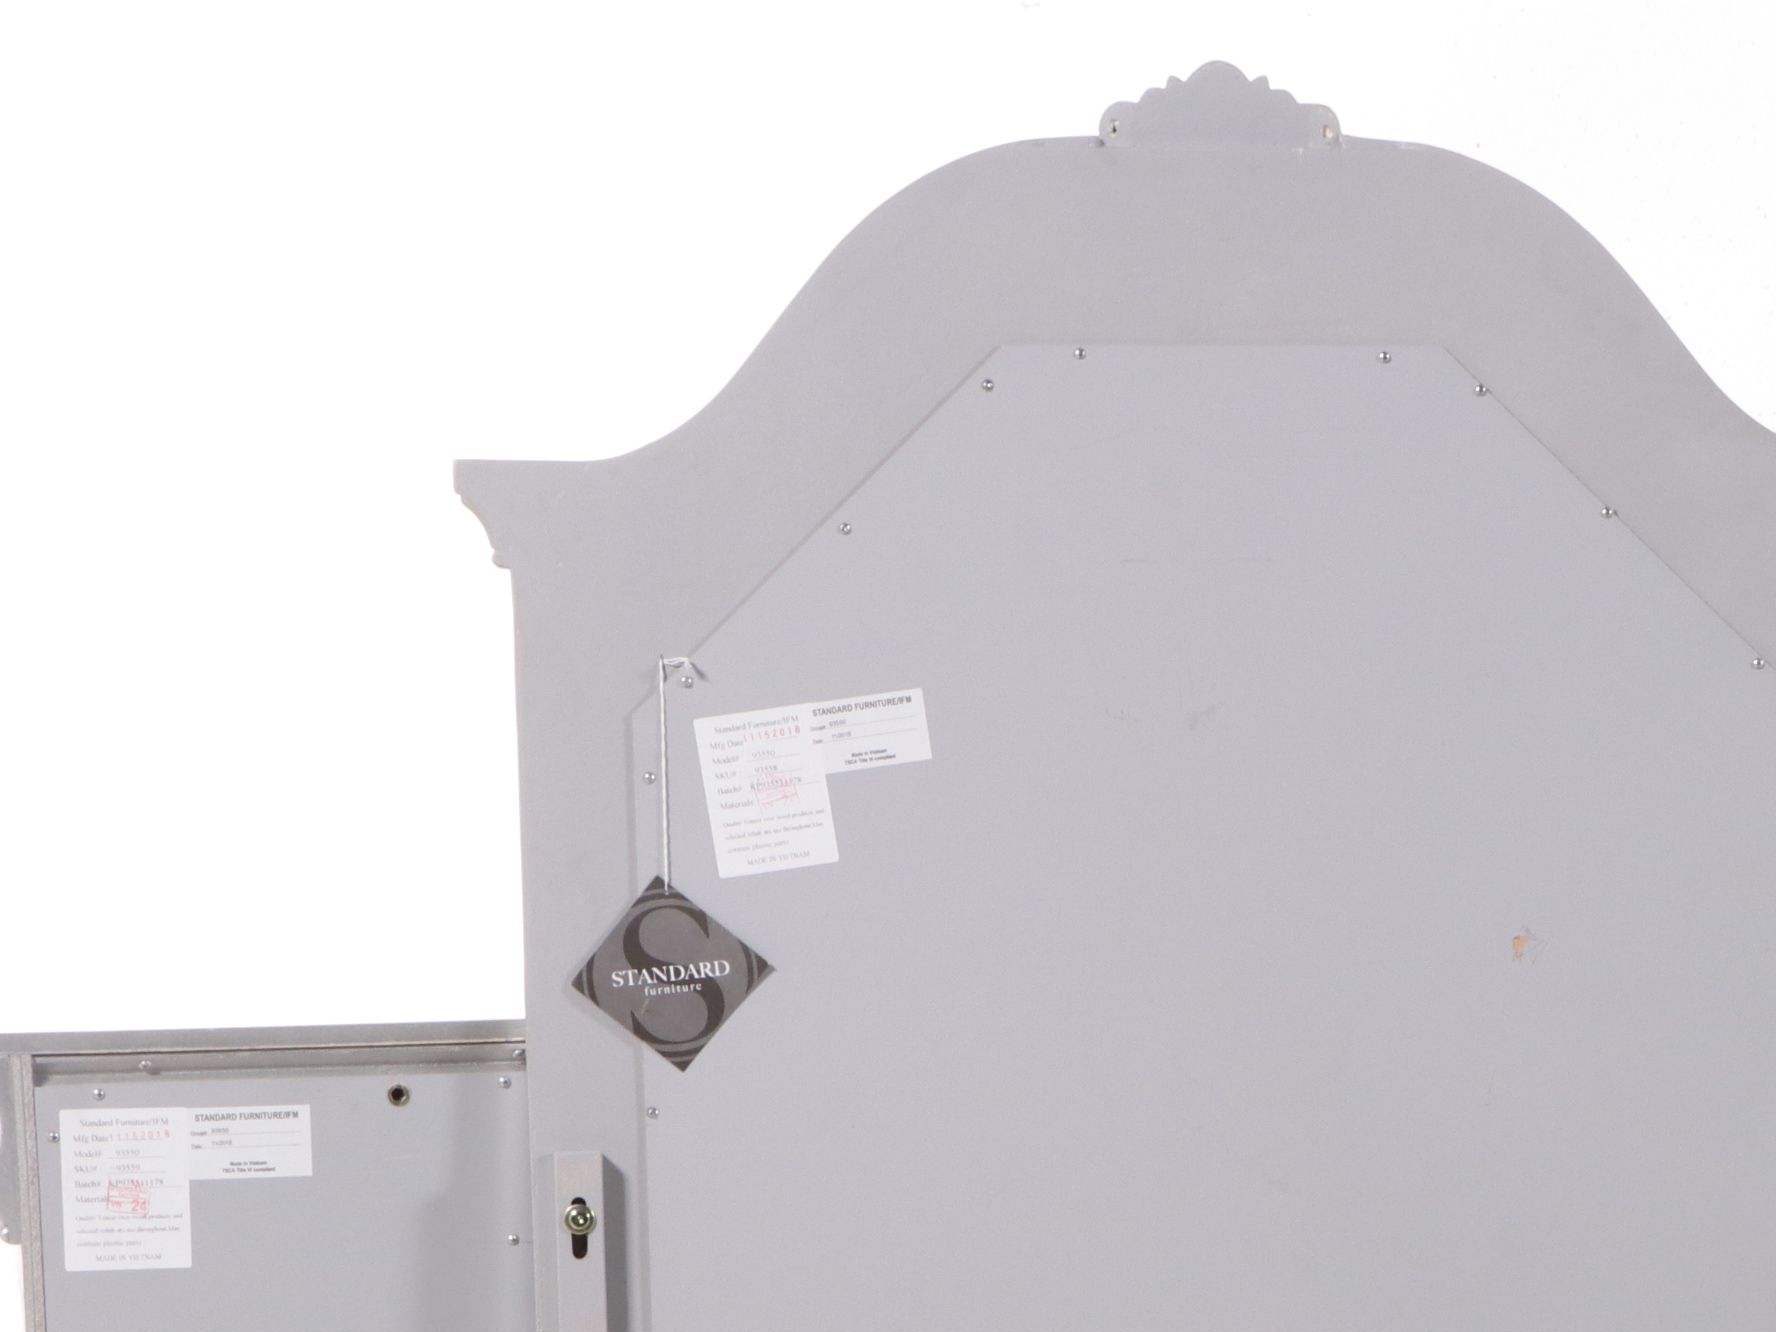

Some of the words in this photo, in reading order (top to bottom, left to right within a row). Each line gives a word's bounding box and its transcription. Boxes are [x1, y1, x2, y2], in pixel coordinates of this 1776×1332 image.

[812, 704, 853, 717] STANDARD
[855, 696, 912, 711] FURNITURE/IFM
[714, 721, 746, 734] Standard
[611, 960, 730, 988] STANDARD
[623, 905, 725, 1044] S
[644, 982, 702, 996] furniture
[80, 1119, 113, 1127] Standard
[195, 1112, 237, 1122] STANDARD
[239, 1111, 298, 1121] FURNITURE/IFM
[73, 1135, 89, 1144] Mfg
[91, 1134, 109, 1143] Date
